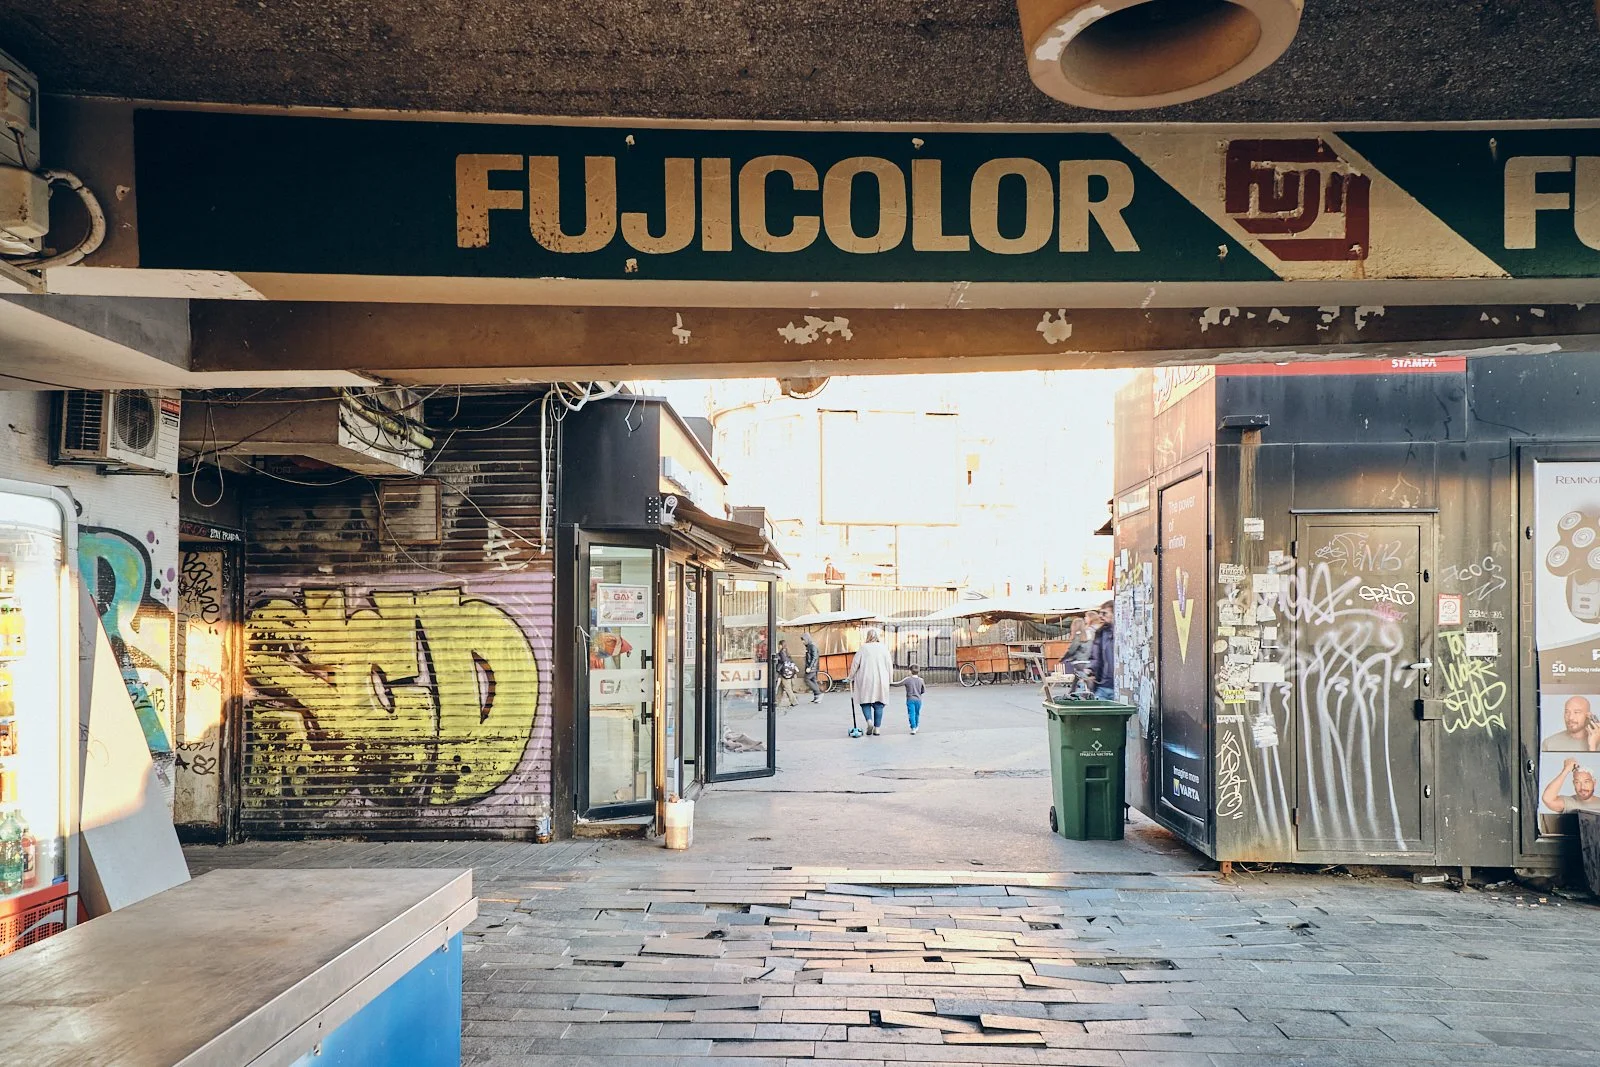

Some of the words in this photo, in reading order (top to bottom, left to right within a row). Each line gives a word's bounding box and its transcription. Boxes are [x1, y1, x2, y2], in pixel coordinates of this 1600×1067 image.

[456, 154, 1141, 254] FUJICOLOR
[1391, 359, 1437, 368] STAMPA
[1556, 476, 1600, 484] REMING
[1168, 501, 1178, 514] The
[1179, 496, 1195, 514] power
[1169, 518, 1174, 532] of
[1169, 535, 1186, 549] infinity
[1552, 663, 1566, 672] 50
[1173, 765, 1188, 779] Imagine
[1189, 773, 1200, 784] more
[1180, 783, 1200, 802] VARTA
